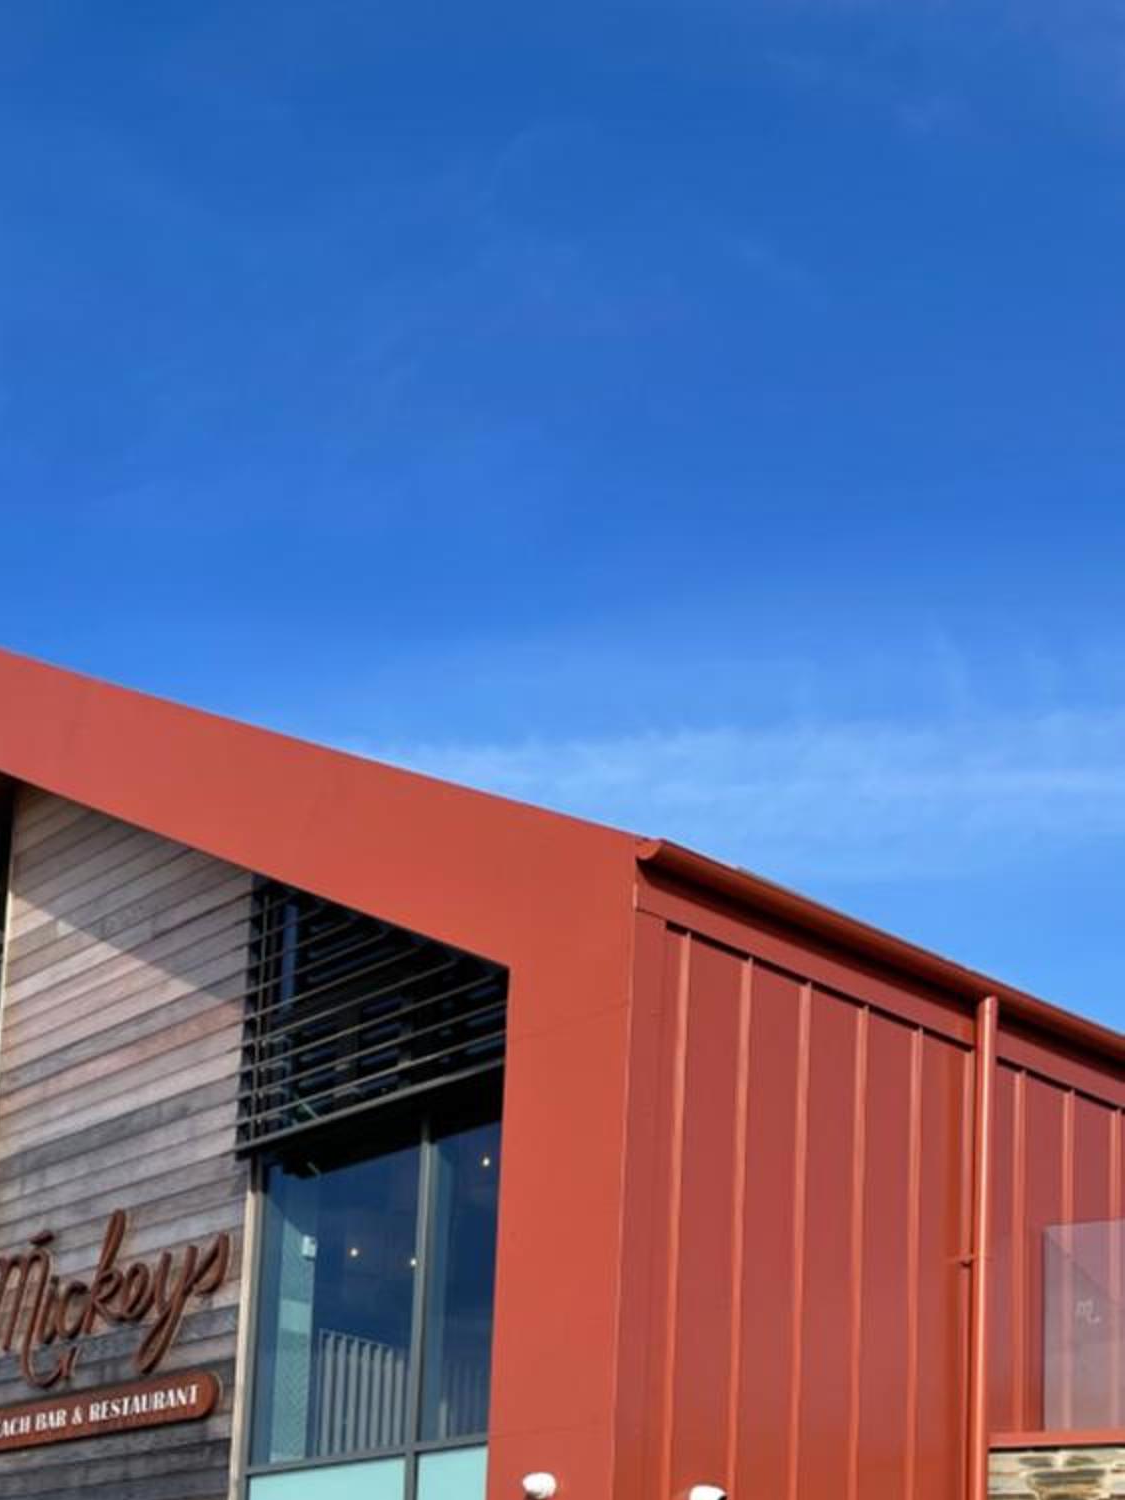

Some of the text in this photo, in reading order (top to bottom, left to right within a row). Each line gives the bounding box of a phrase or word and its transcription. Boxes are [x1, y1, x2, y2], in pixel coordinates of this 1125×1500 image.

[35, 1408, 67, 1433] BAR
[71, 1405, 83, 1425] &
[88, 1384, 201, 1420] RESTAURANT
